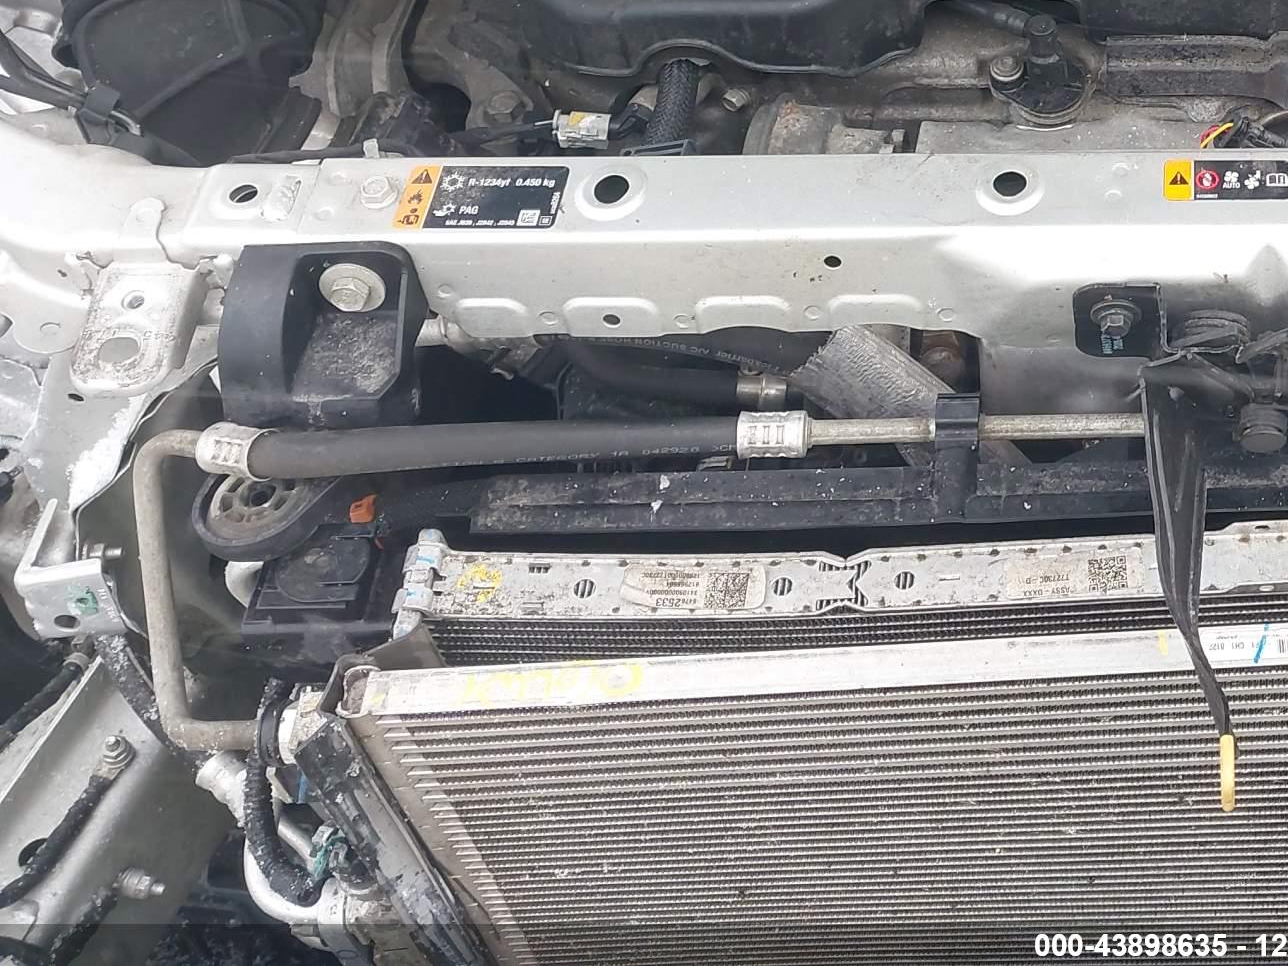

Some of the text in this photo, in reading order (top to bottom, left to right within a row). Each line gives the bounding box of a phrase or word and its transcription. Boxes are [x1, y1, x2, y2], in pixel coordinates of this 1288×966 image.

[468, 178, 556, 188] R-1234yf 0.450 kg
[459, 205, 479, 215] PAG
[1051, 585, 1070, 595] ASSY
